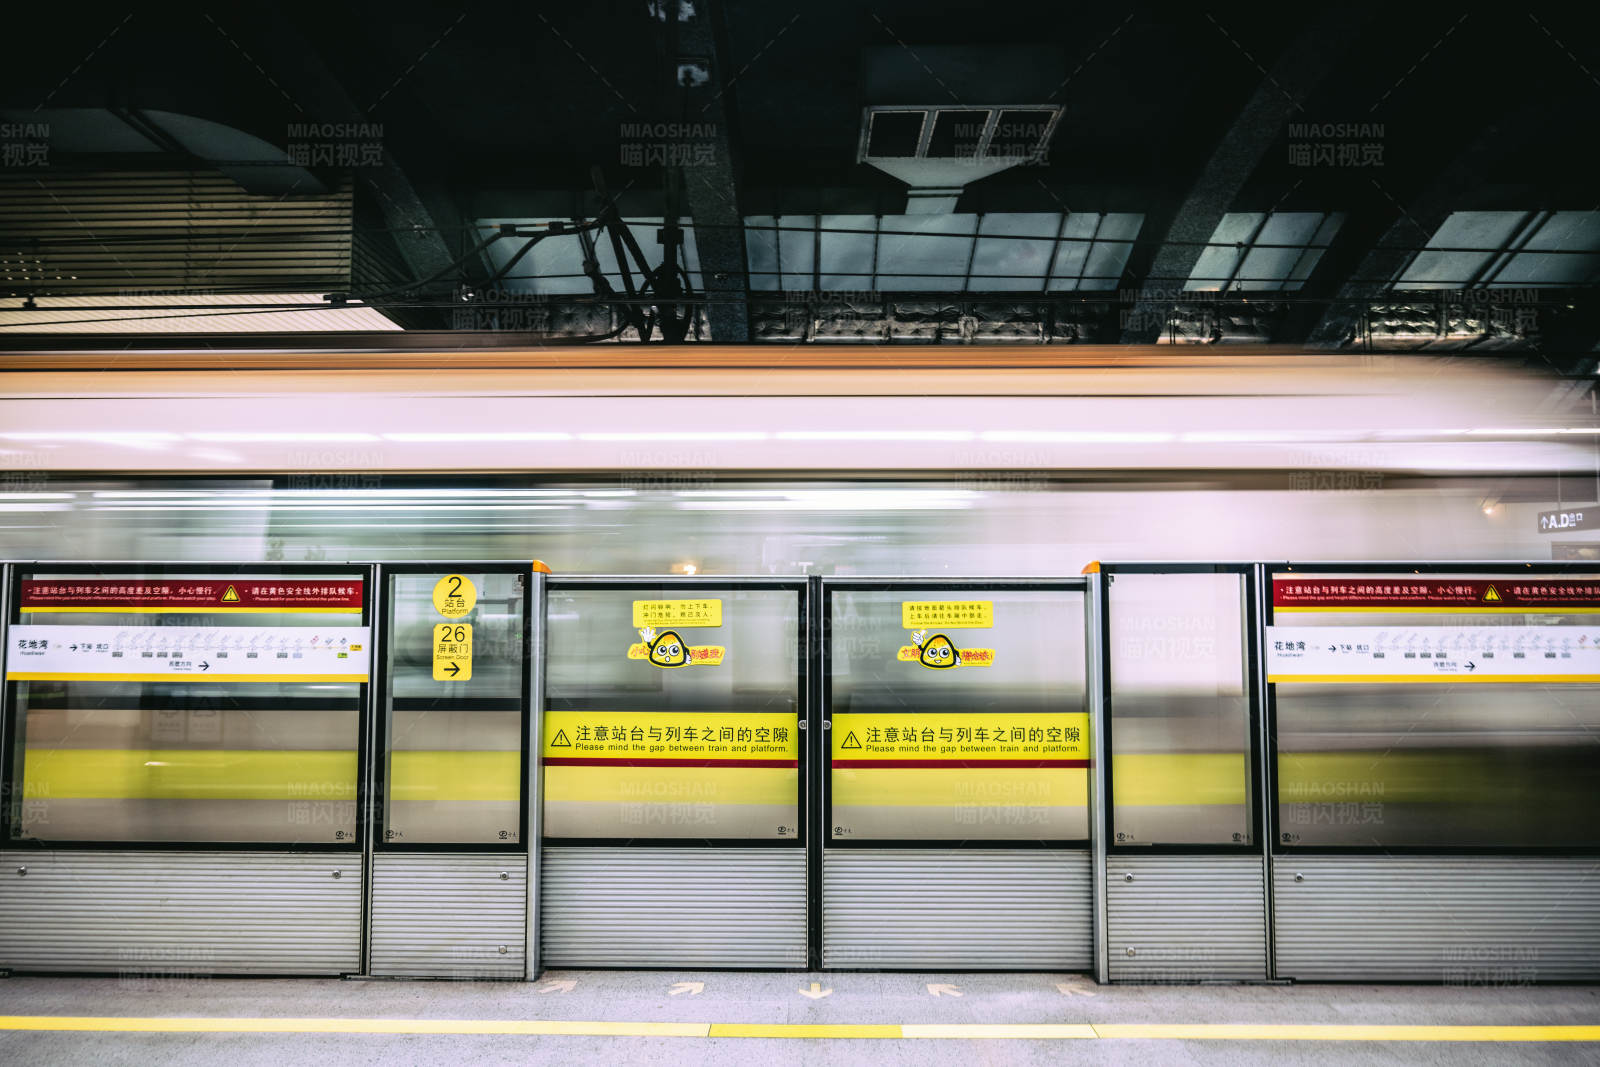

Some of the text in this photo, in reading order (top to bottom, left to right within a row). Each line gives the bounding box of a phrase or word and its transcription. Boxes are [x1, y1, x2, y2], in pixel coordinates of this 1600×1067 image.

[448, 576, 462, 597] 2
[444, 598, 465, 607] 站台
[442, 626, 465, 642] 26
[18, 640, 47, 649] 花地湾
[438, 644, 468, 654] 屏蔽门
[1274, 642, 1305, 650] 花地湾
[576, 726, 788, 742] 注意站台与列车之间的空隙
[866, 727, 1080, 743] 注意站台与列车之间的空隙
[751, 745, 788, 753] platform.
[1043, 745, 1080, 753] platform.
